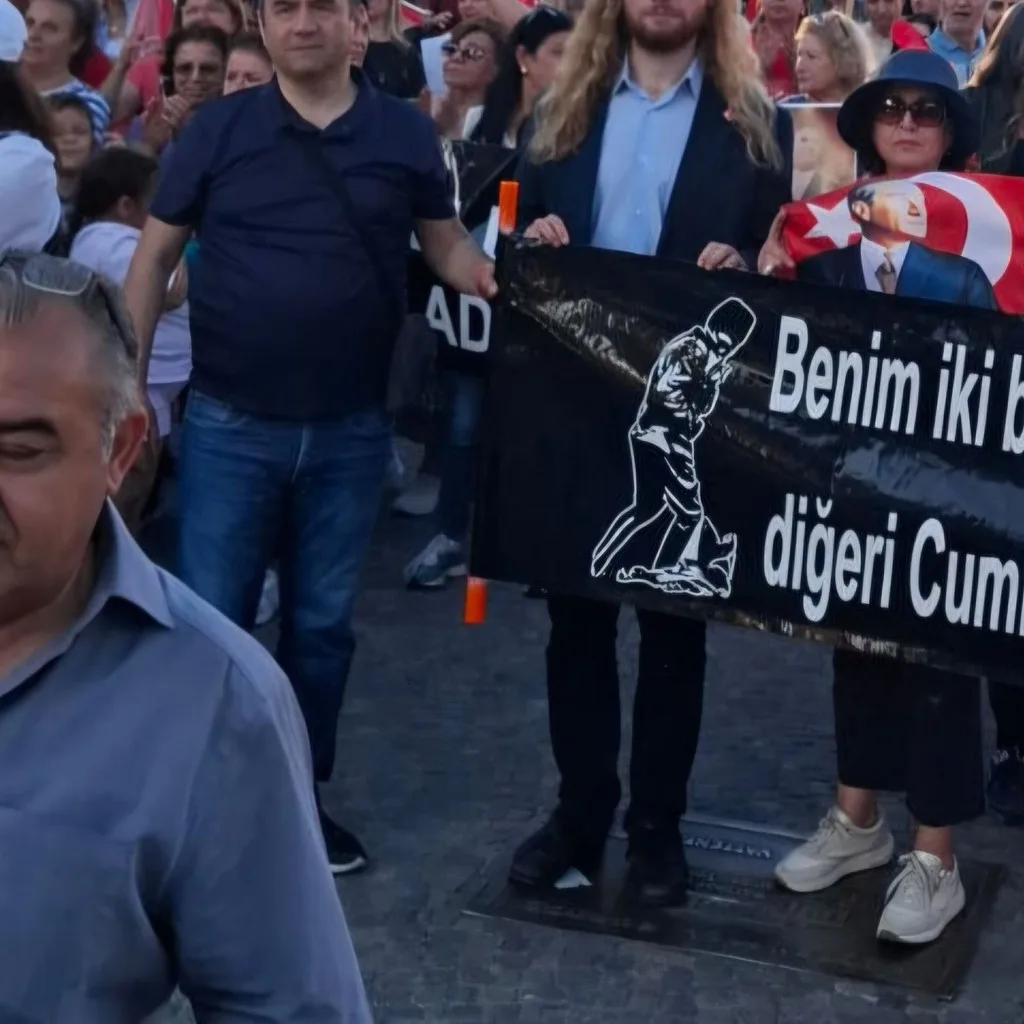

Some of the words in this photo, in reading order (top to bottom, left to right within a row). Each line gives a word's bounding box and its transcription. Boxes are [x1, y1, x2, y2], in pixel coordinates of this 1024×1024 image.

[769, 316, 920, 435] Benim
[932, 342, 995, 446] iki
[763, 493, 898, 622] diğeri
